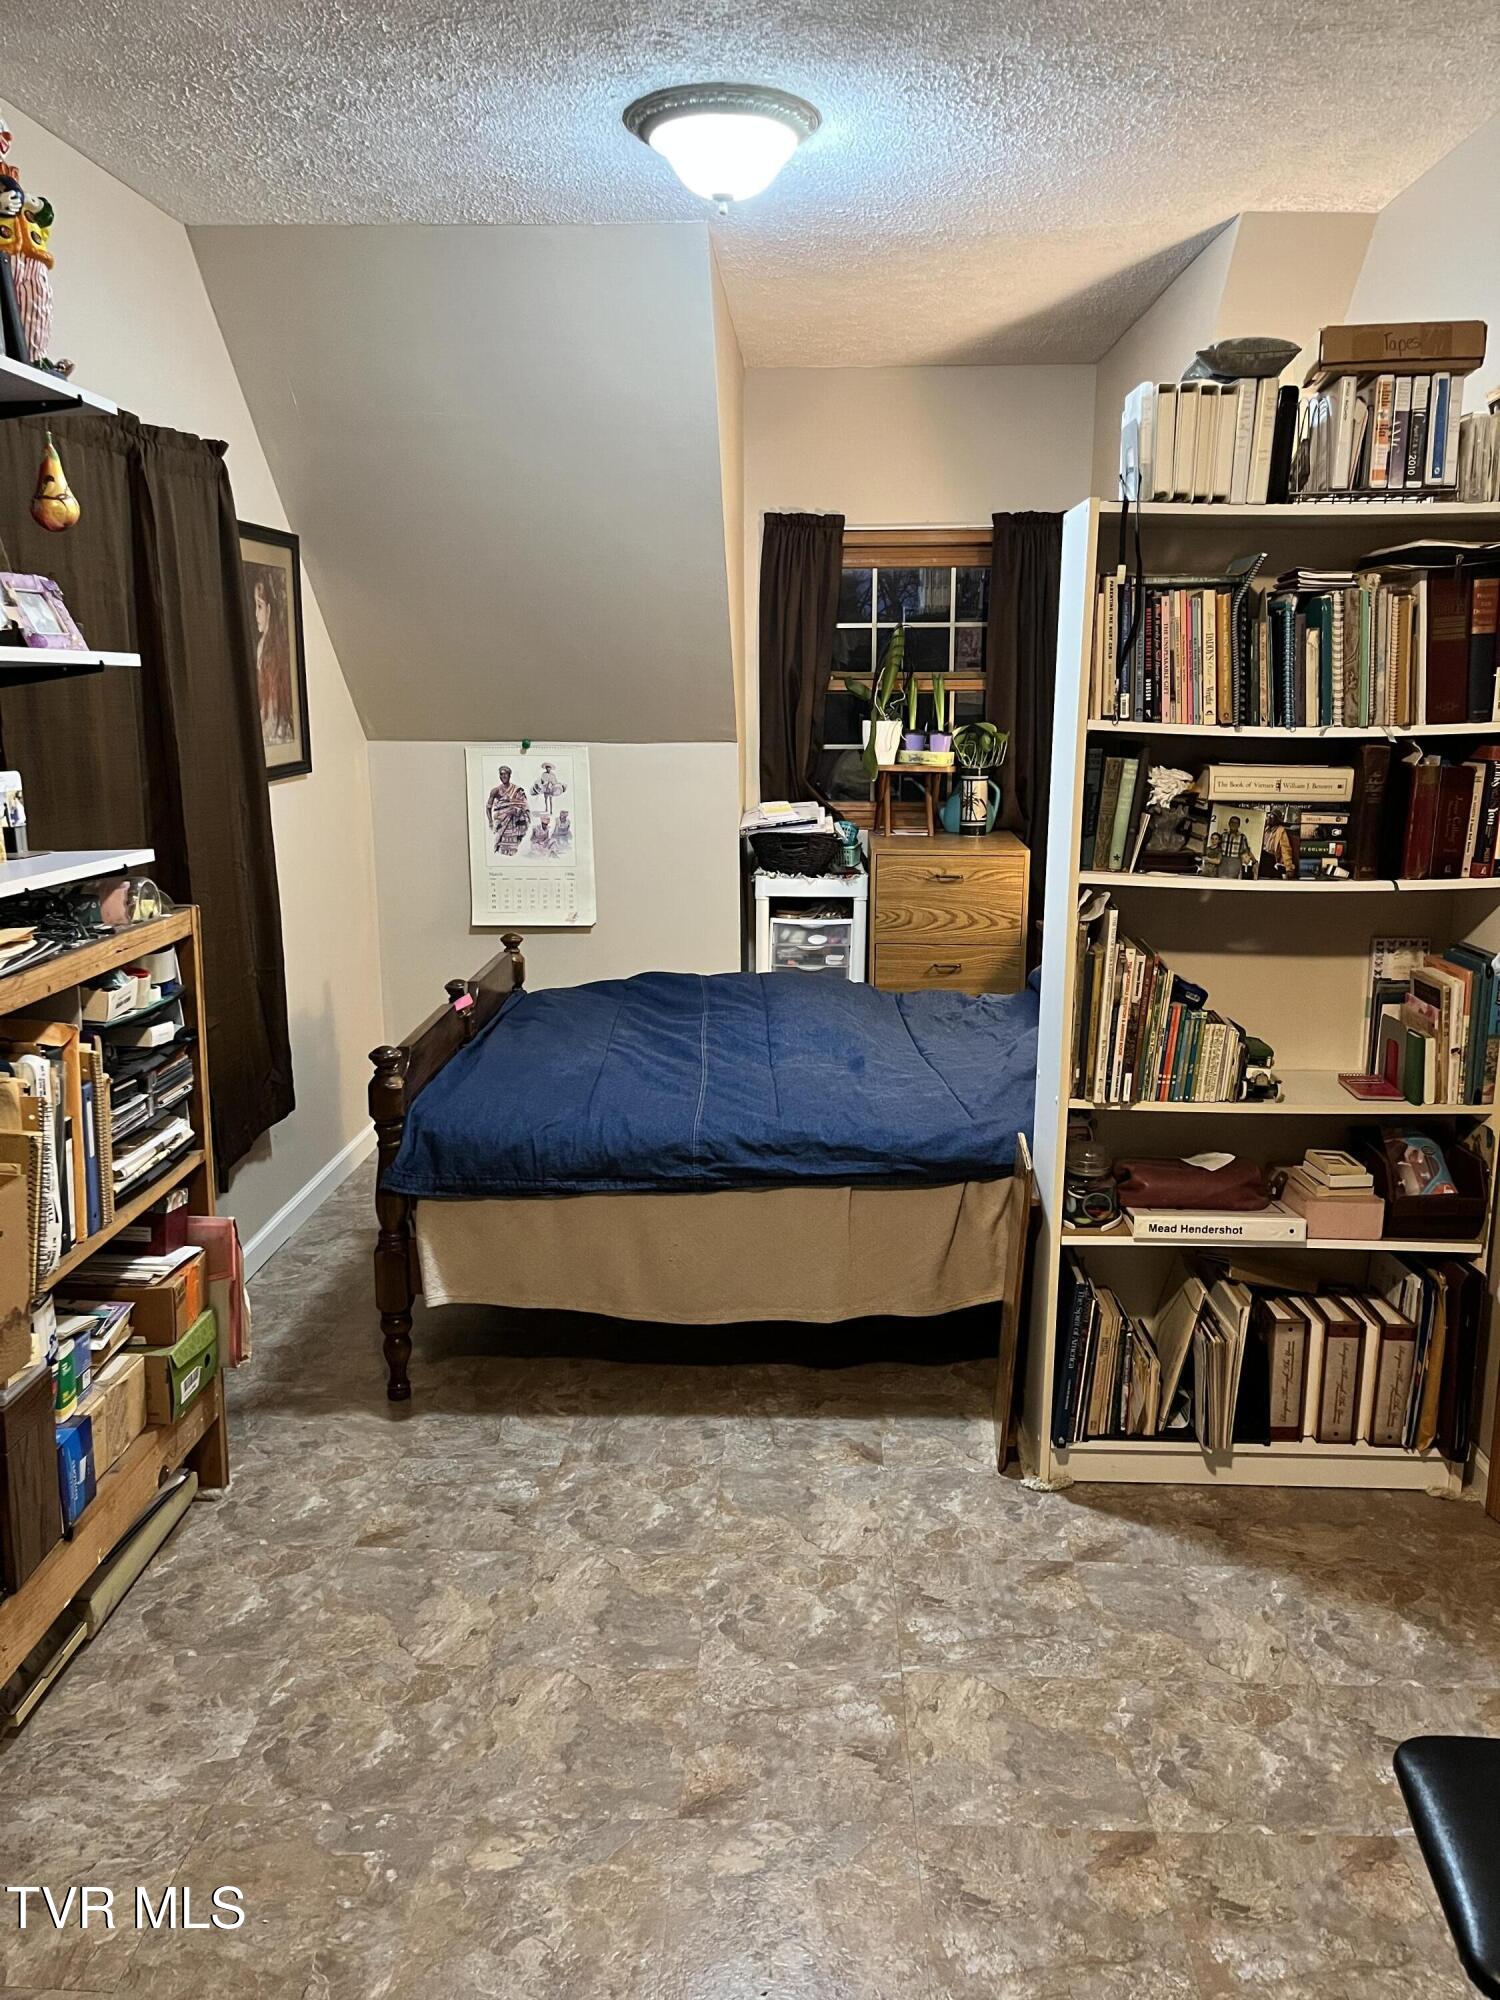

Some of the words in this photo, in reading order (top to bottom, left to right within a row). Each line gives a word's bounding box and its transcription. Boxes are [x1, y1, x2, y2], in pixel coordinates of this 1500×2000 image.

[1384, 331, 1422, 357] Tapes
[1408, 454, 1416, 476] 2010
[1206, 632, 1214, 661] DADDY'S
[1487, 808, 1498, 825] You
[1148, 1224, 1178, 1233] Mead
[1180, 1224, 1243, 1235] Hendershot
[1072, 1306, 1082, 1326] Spirit
[1072, 1328, 1080, 1336] of
[1068, 1337, 1078, 1369] America
